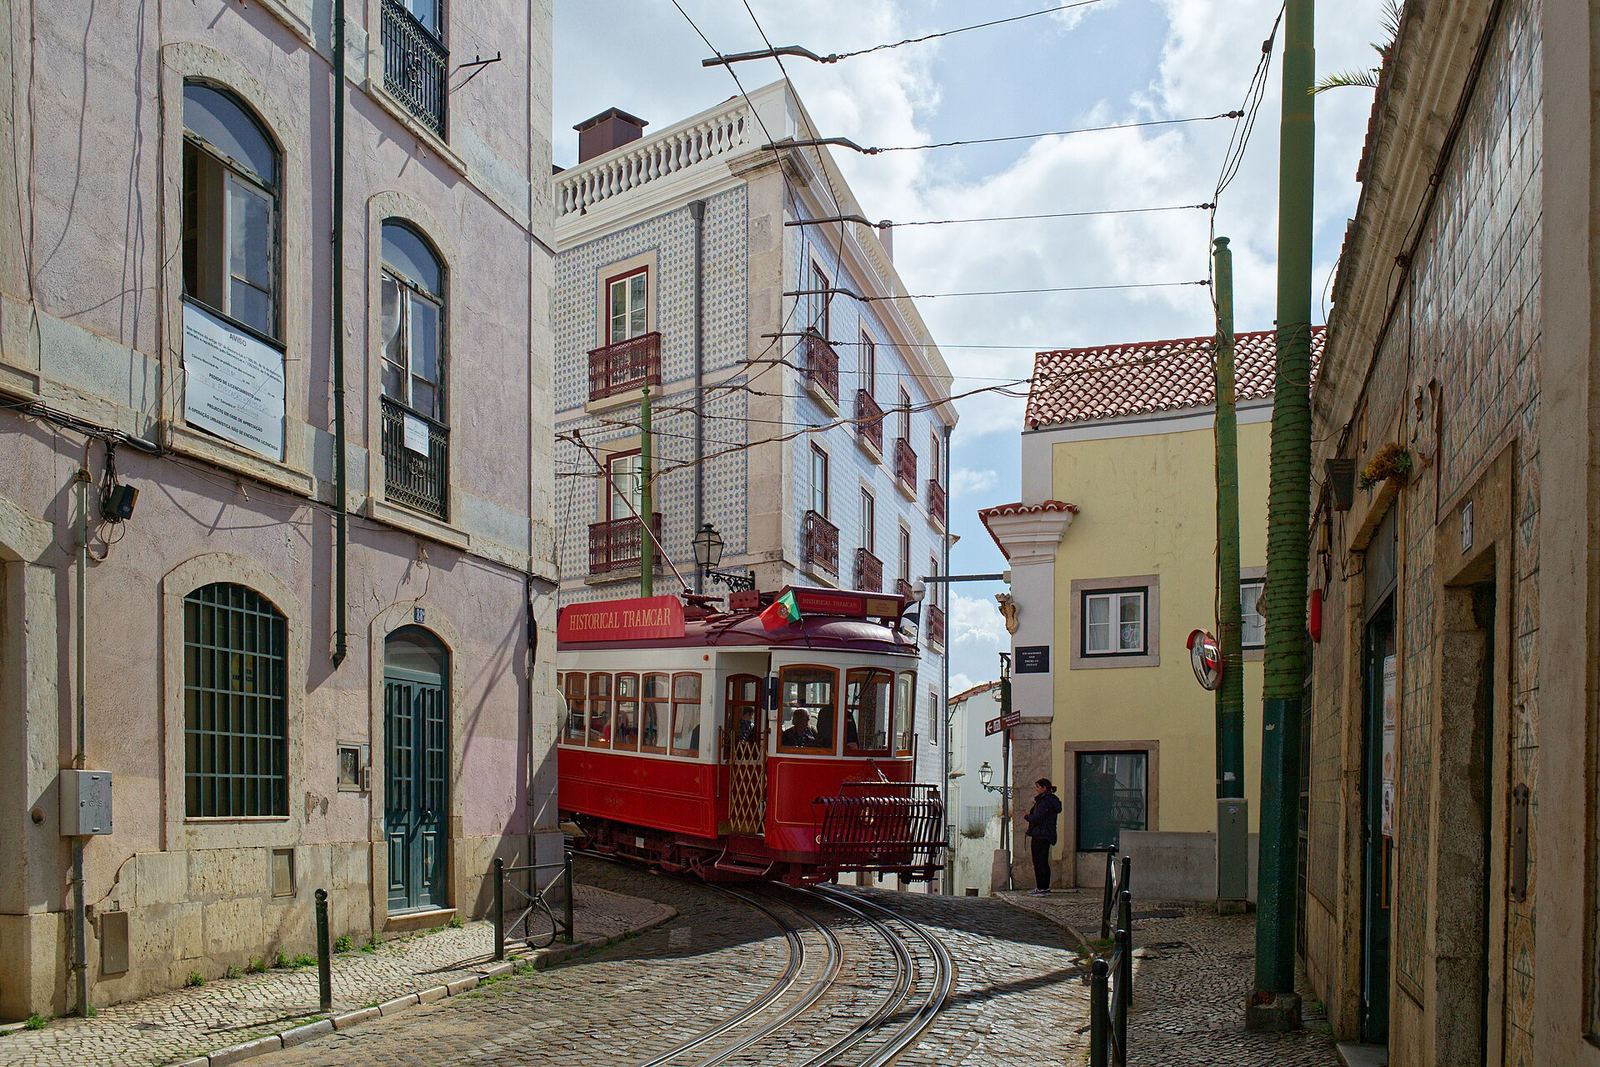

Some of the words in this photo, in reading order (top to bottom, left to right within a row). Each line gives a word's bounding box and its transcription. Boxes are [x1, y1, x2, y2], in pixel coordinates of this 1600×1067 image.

[229, 333, 247, 347] AVISO
[802, 598, 831, 607] HISTORICAL
[569, 612, 620, 630] HISTORICAL
[623, 608, 671, 628] TRAMCAR
